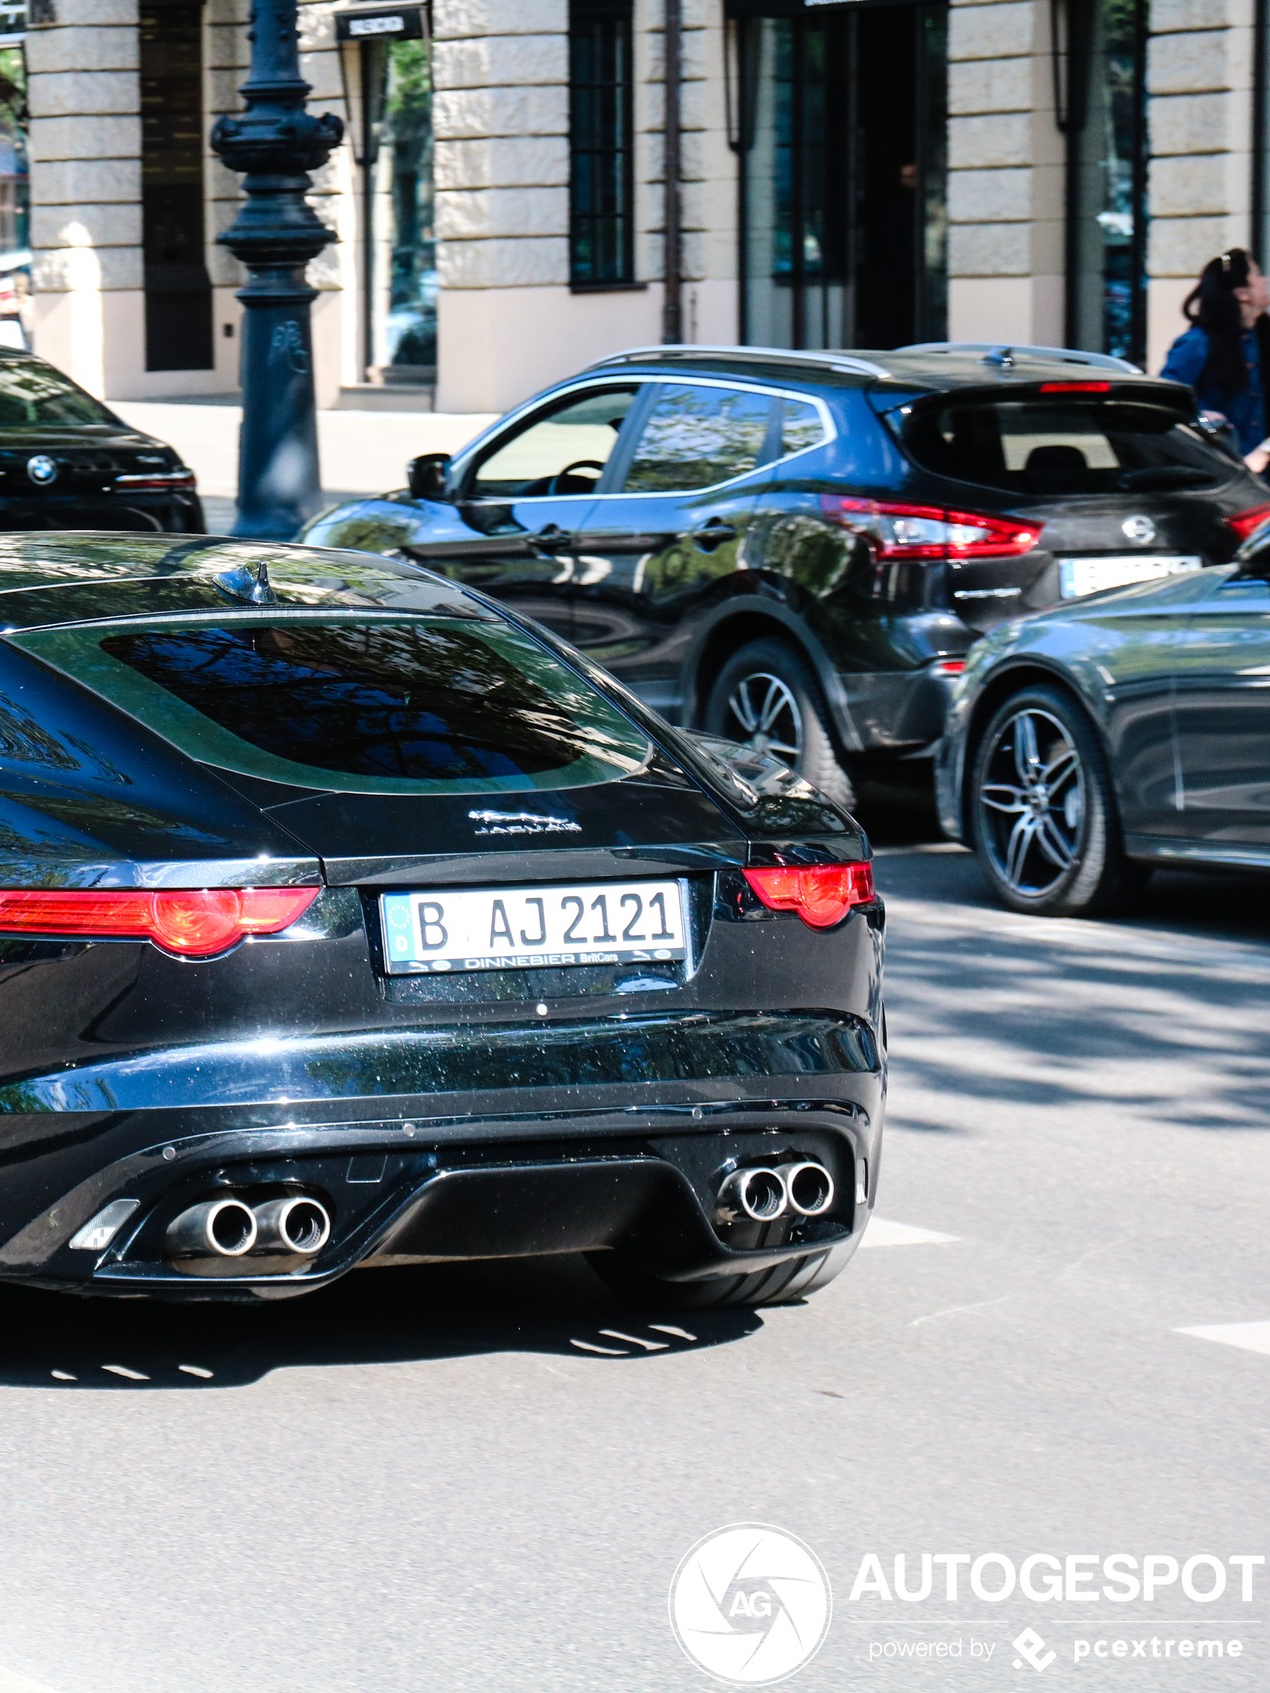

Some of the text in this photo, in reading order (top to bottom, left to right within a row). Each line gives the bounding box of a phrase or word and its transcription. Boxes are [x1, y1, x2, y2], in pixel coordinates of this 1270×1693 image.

[475, 822, 582, 836] JAGUAR
[418, 892, 675, 951] B AJ 2121
[395, 935, 409, 952] D
[465, 954, 576, 970] DINNEBIER
[580, 951, 619, 964] BritCars
